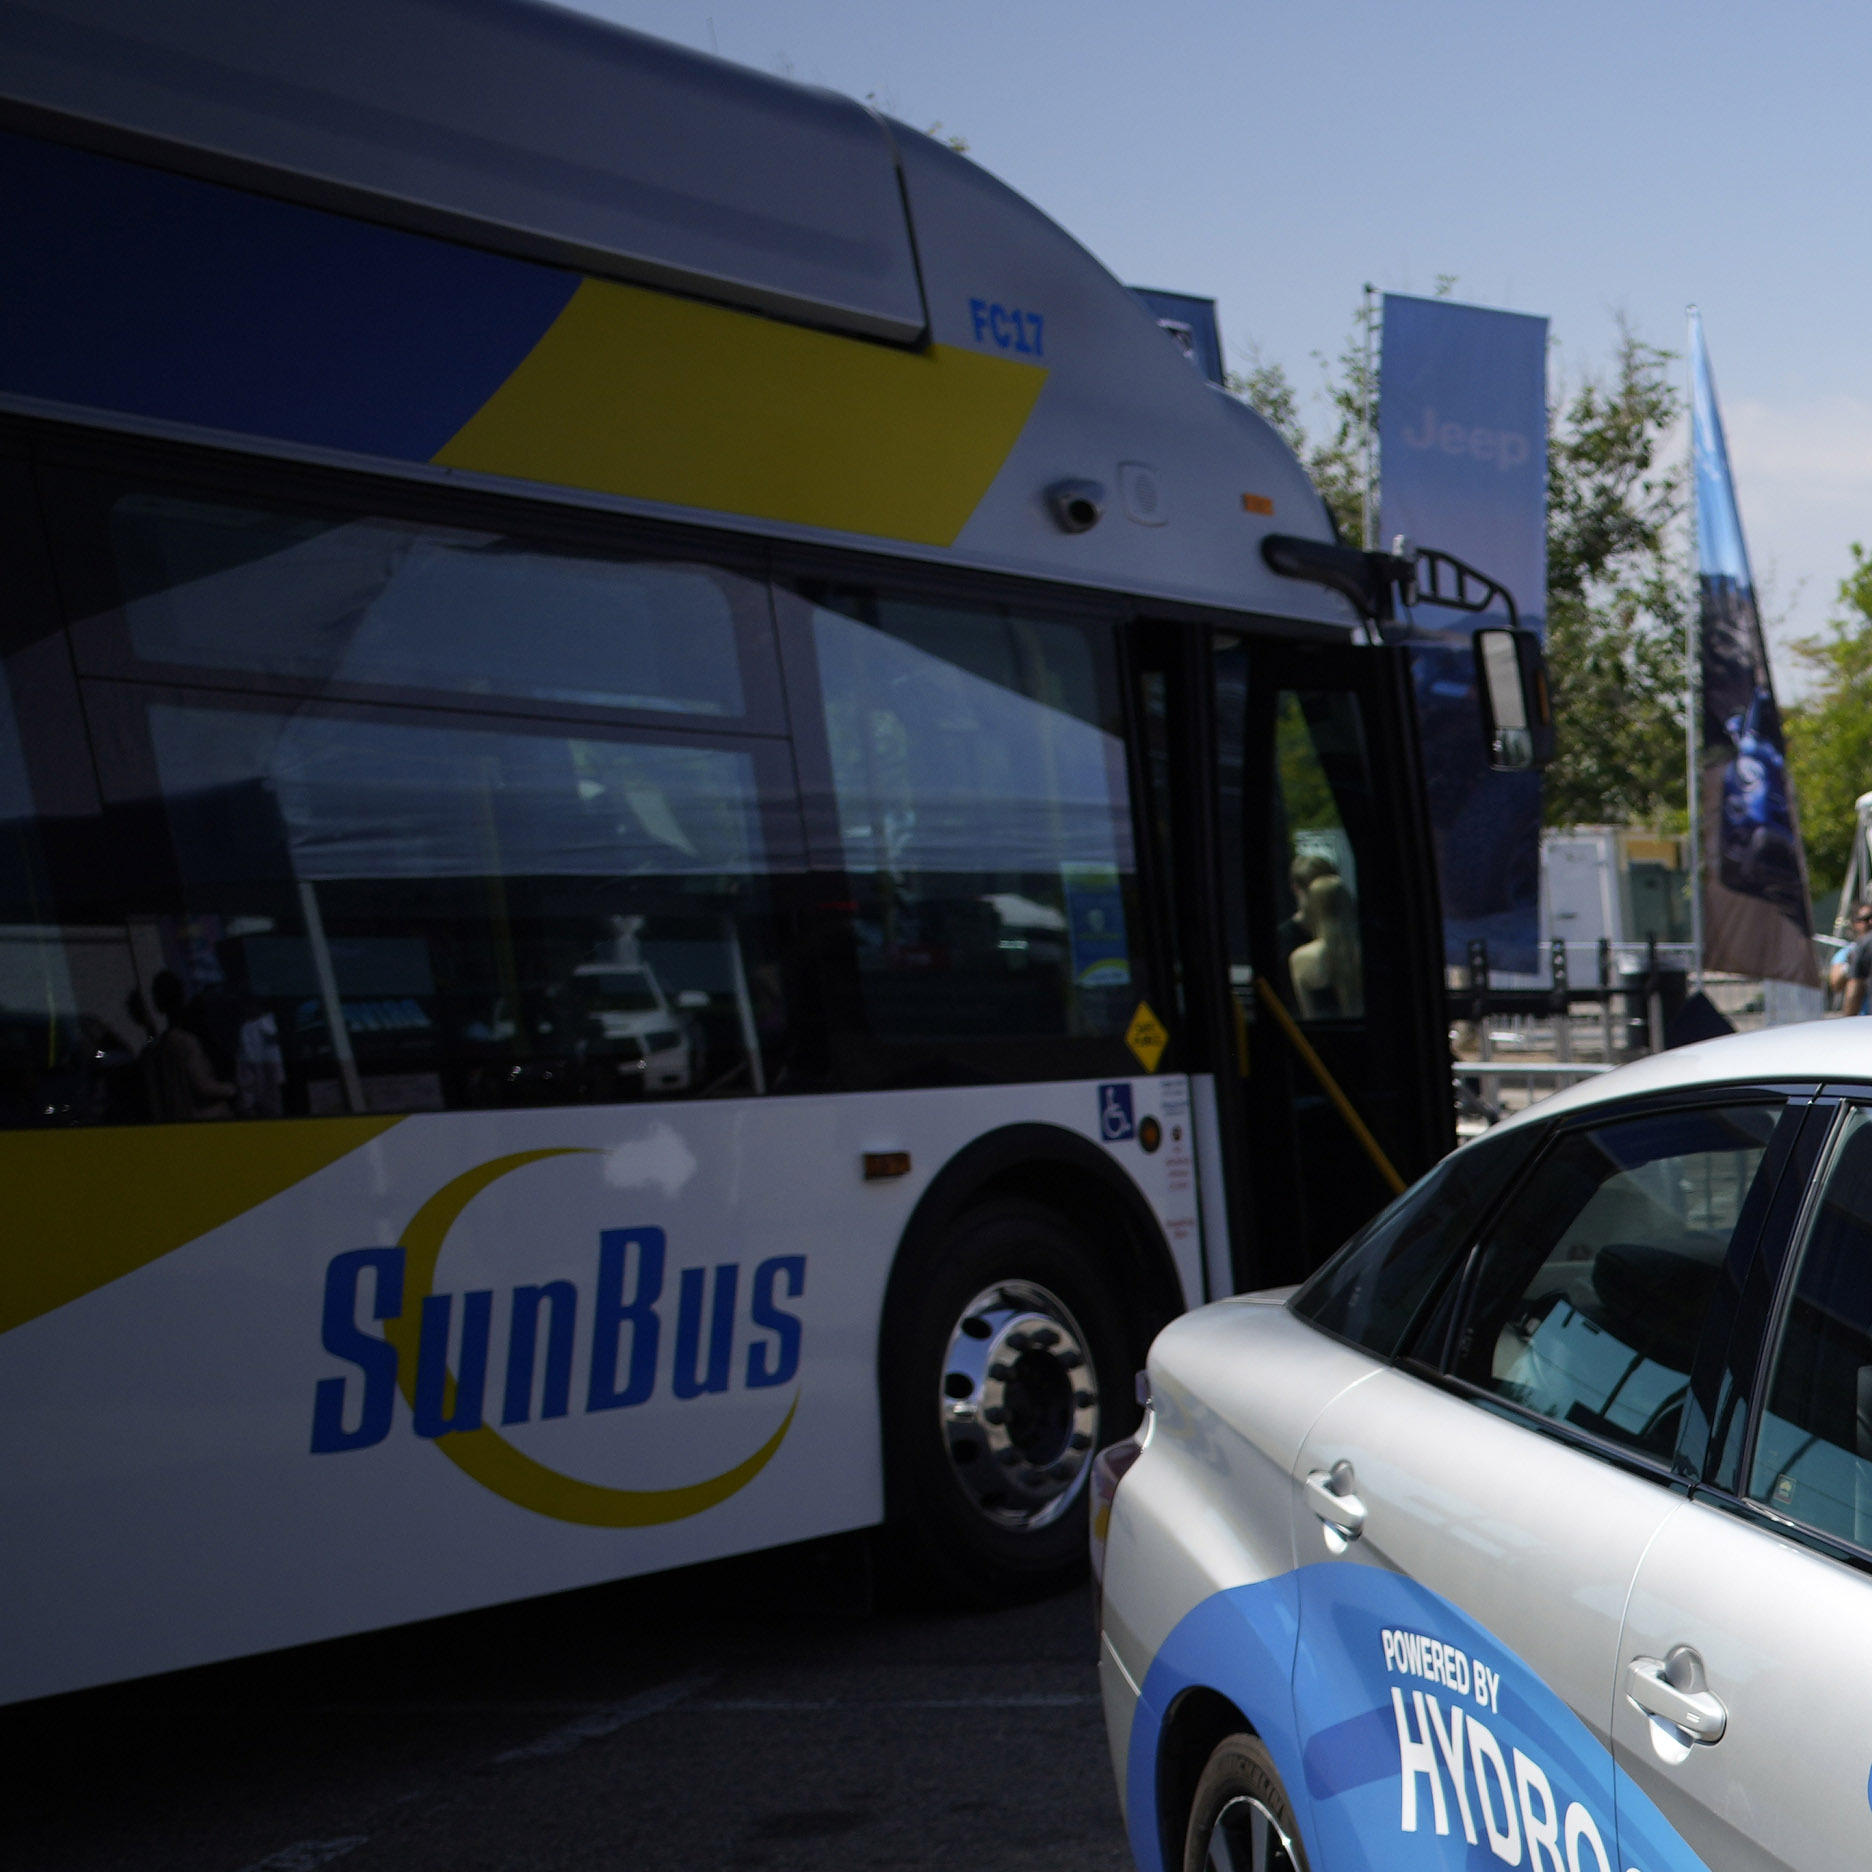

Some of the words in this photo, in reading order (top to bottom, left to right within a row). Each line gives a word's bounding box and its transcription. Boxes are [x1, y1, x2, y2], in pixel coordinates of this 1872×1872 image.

[967, 296, 1046, 359] FC17
[1404, 405, 1531, 470] Jeep
[310, 1225, 808, 1455] SunBus
[1381, 1628, 1472, 1696] POWERED
[1472, 1667, 1500, 1713] BY
